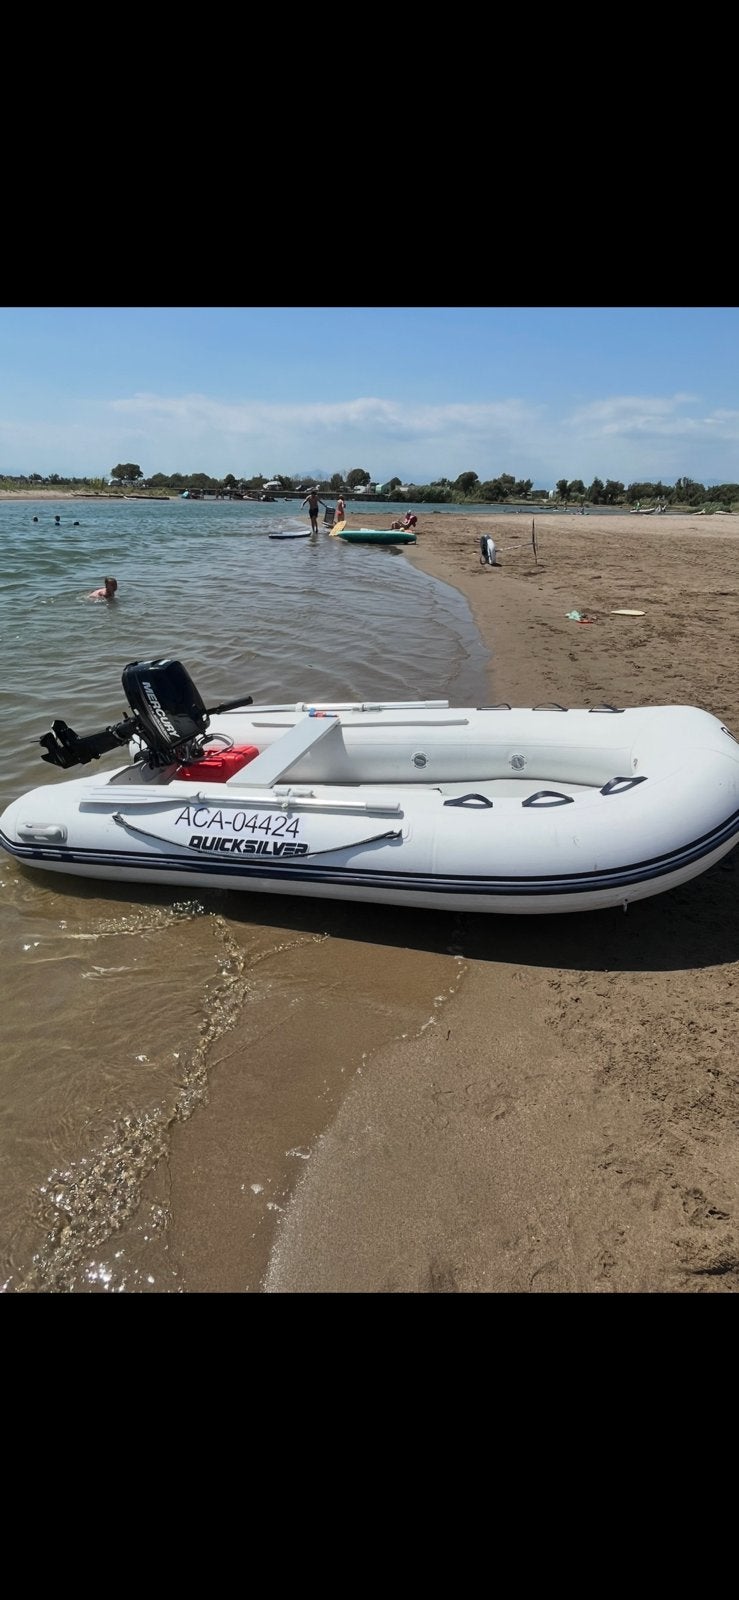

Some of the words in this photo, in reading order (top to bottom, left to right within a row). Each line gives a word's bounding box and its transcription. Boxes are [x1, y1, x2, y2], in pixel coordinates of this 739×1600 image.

[142, 681, 180, 738] MERCURY
[175, 806, 300, 838] ACA-04424
[188, 835, 309, 856] QUICKSILVER
